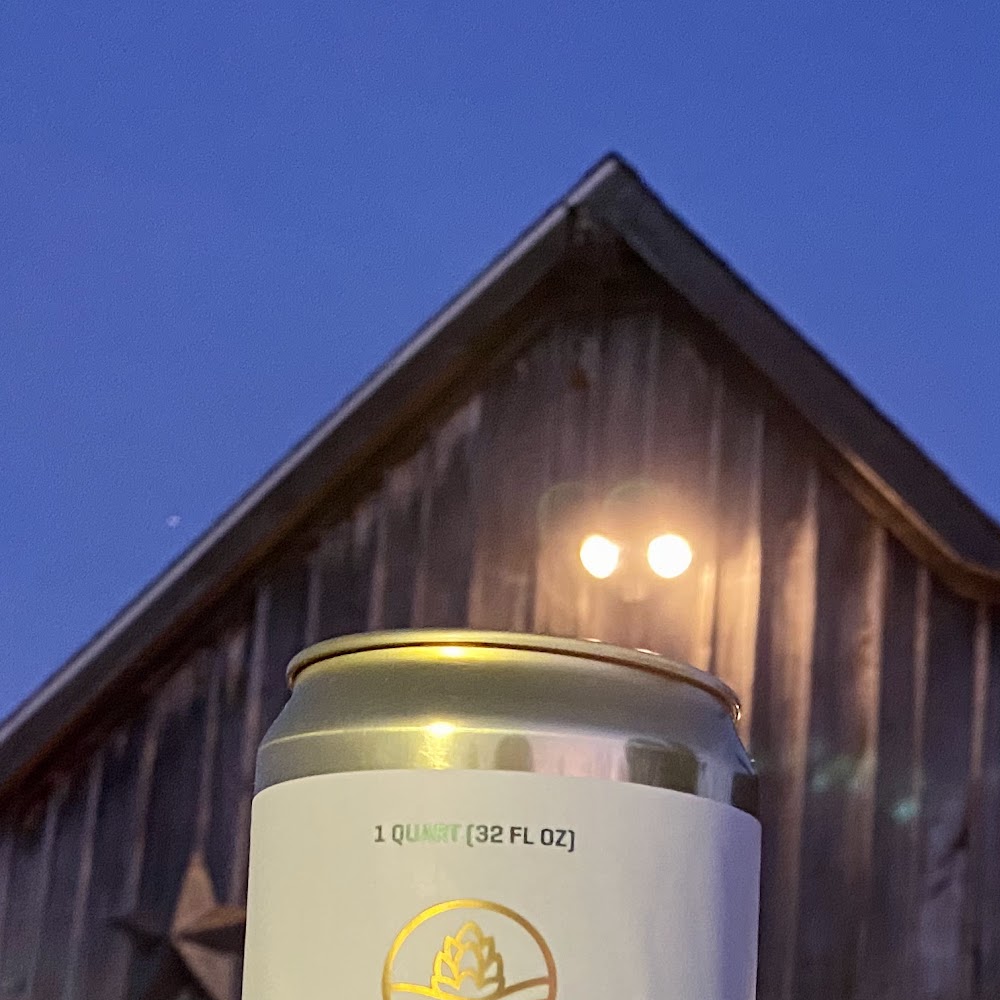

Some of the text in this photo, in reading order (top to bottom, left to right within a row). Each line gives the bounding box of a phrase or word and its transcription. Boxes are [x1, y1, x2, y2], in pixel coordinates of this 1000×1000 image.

[374, 825, 385, 843] 1
[392, 824, 462, 845] QUART
[510, 826, 534, 845] FL
